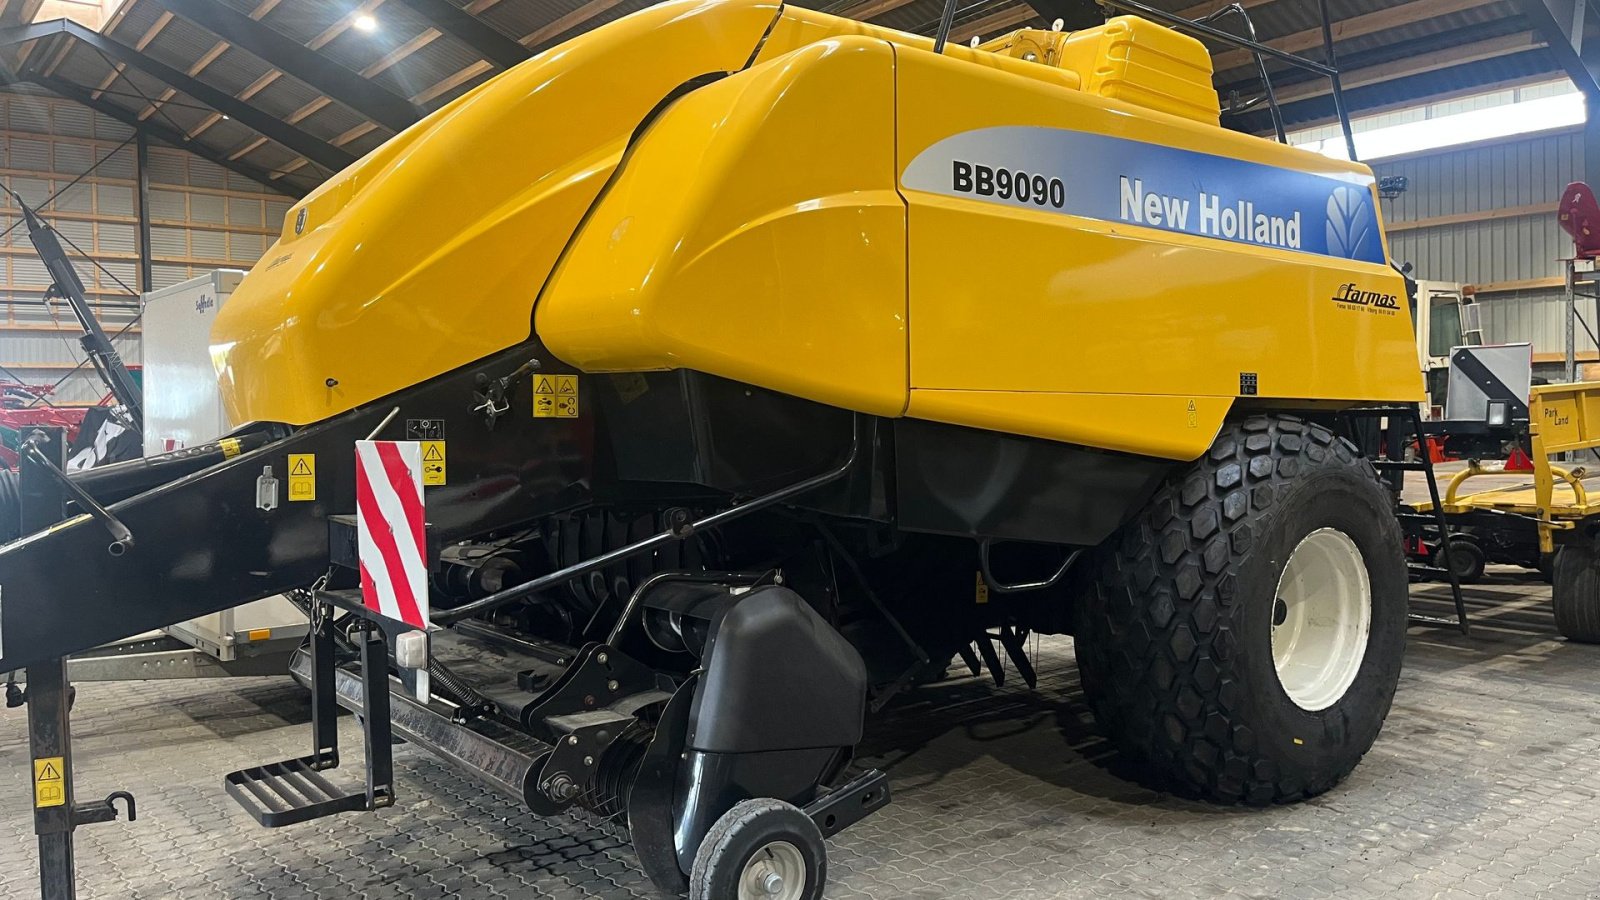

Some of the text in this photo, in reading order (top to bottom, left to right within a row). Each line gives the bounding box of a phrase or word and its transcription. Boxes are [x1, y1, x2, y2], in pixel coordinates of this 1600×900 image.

[952, 160, 1065, 209] BB9090
[1119, 175, 1301, 249] New Holland
[1343, 283, 1397, 307] Farmas
[1544, 408, 1558, 418] Park
[1554, 415, 1568, 425] Land
